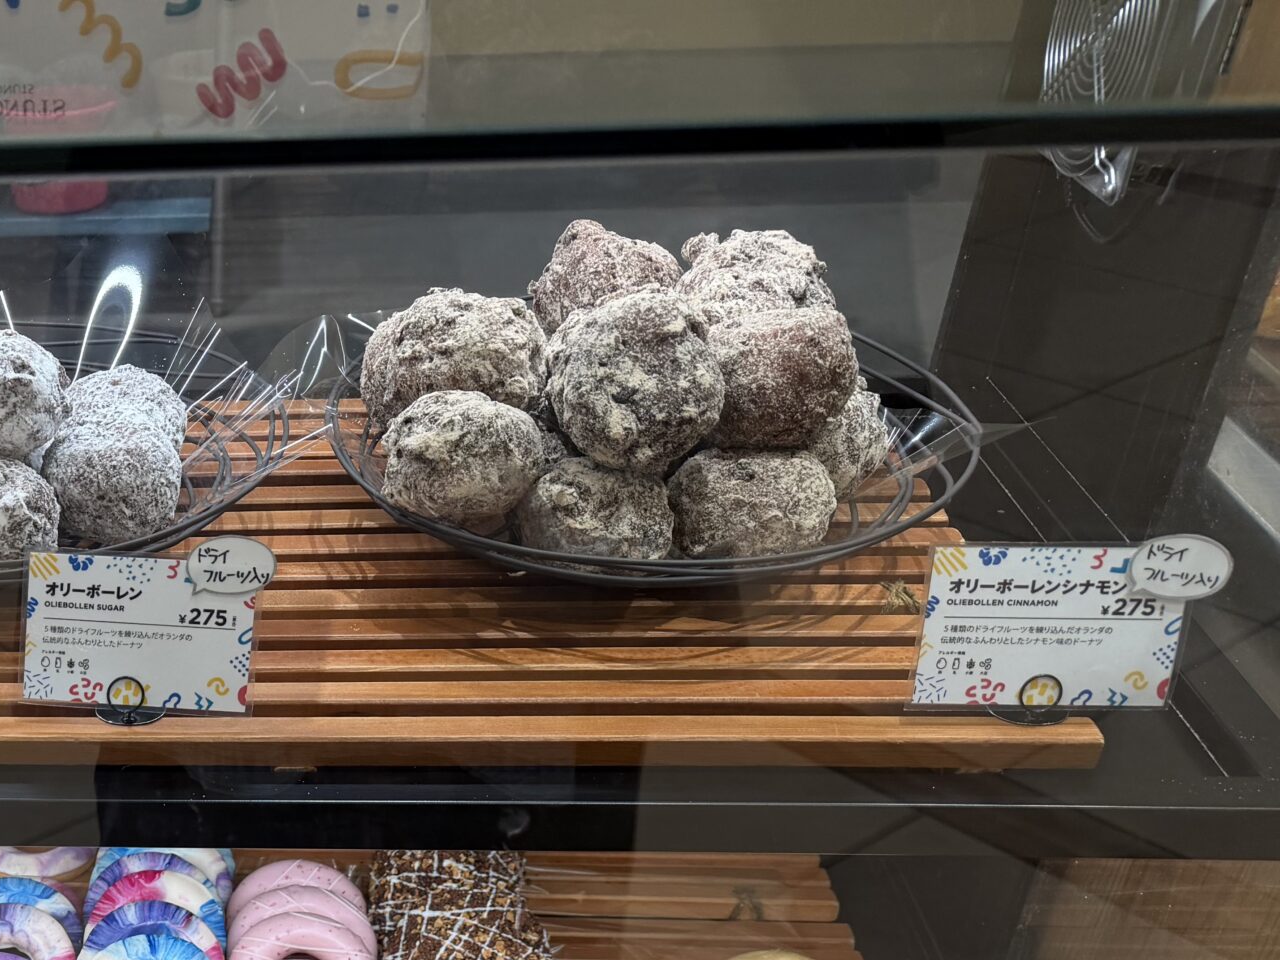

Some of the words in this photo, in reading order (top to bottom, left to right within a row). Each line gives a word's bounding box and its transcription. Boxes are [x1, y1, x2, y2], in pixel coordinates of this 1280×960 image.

[197, 547, 230, 565] ドライ
[1147, 544, 1189, 562] ドライ
[203, 567, 270, 585] フルーツ入り
[1143, 567, 1219, 588] フルーツ入り
[45, 582, 143, 601] オリーボーレン
[949, 578, 1128, 595] オリーボーレンシナモン
[44, 600, 95, 612] OLIEBOLLEN
[97, 603, 125, 612] SUGAR
[946, 597, 1004, 608] OLIEBOLLEN
[1006, 598, 1058, 608] CINNAMON
